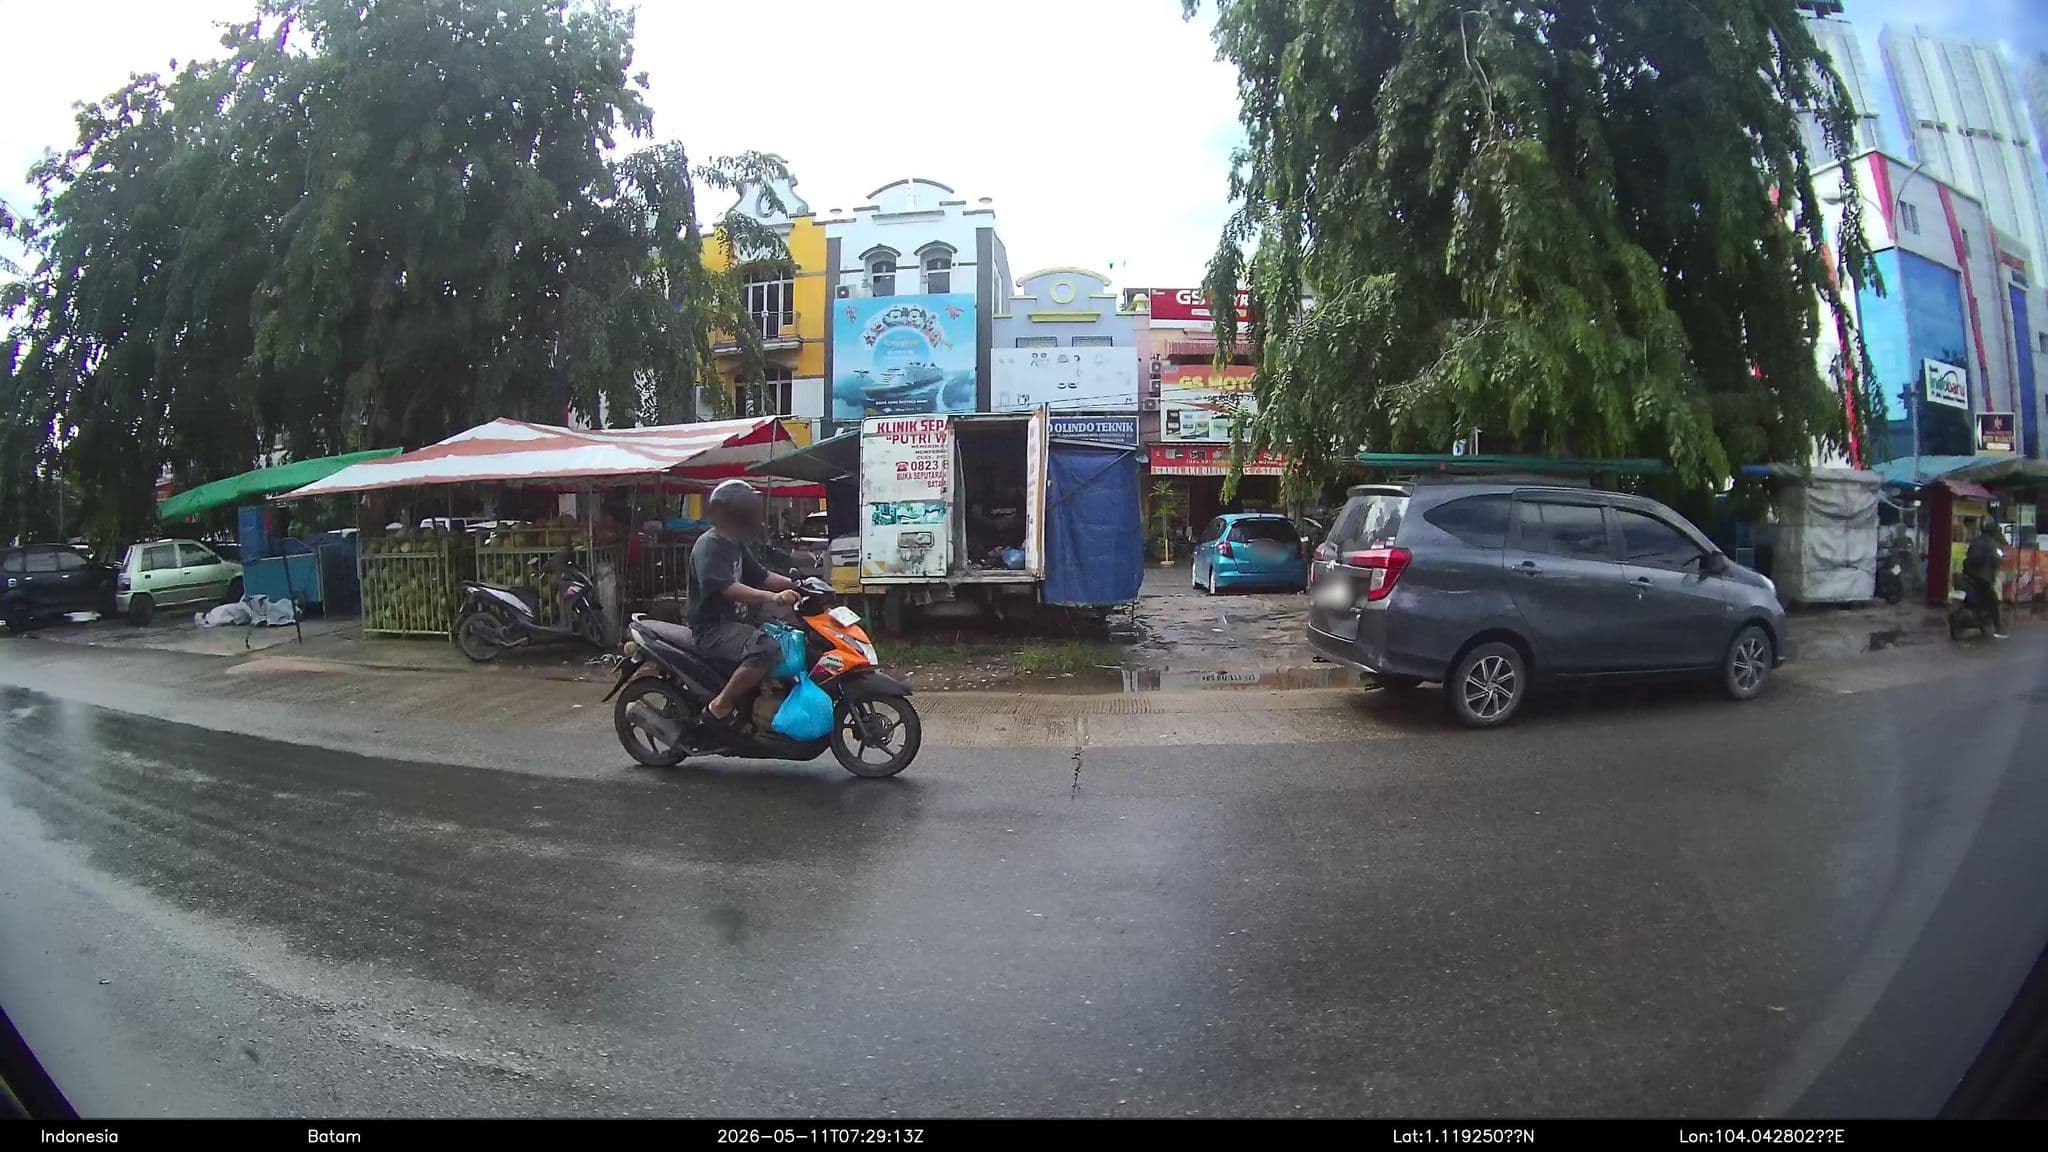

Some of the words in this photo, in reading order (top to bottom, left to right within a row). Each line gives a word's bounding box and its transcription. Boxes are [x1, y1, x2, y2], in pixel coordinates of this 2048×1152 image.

[1176, 290, 1206, 305] GS
[1179, 376, 1203, 388] GS
[877, 421, 917, 434] KLINIK
[1055, 423, 1094, 433] OLINDO
[1095, 422, 1134, 433] TEKNIK
[911, 461, 938, 471] 0823
